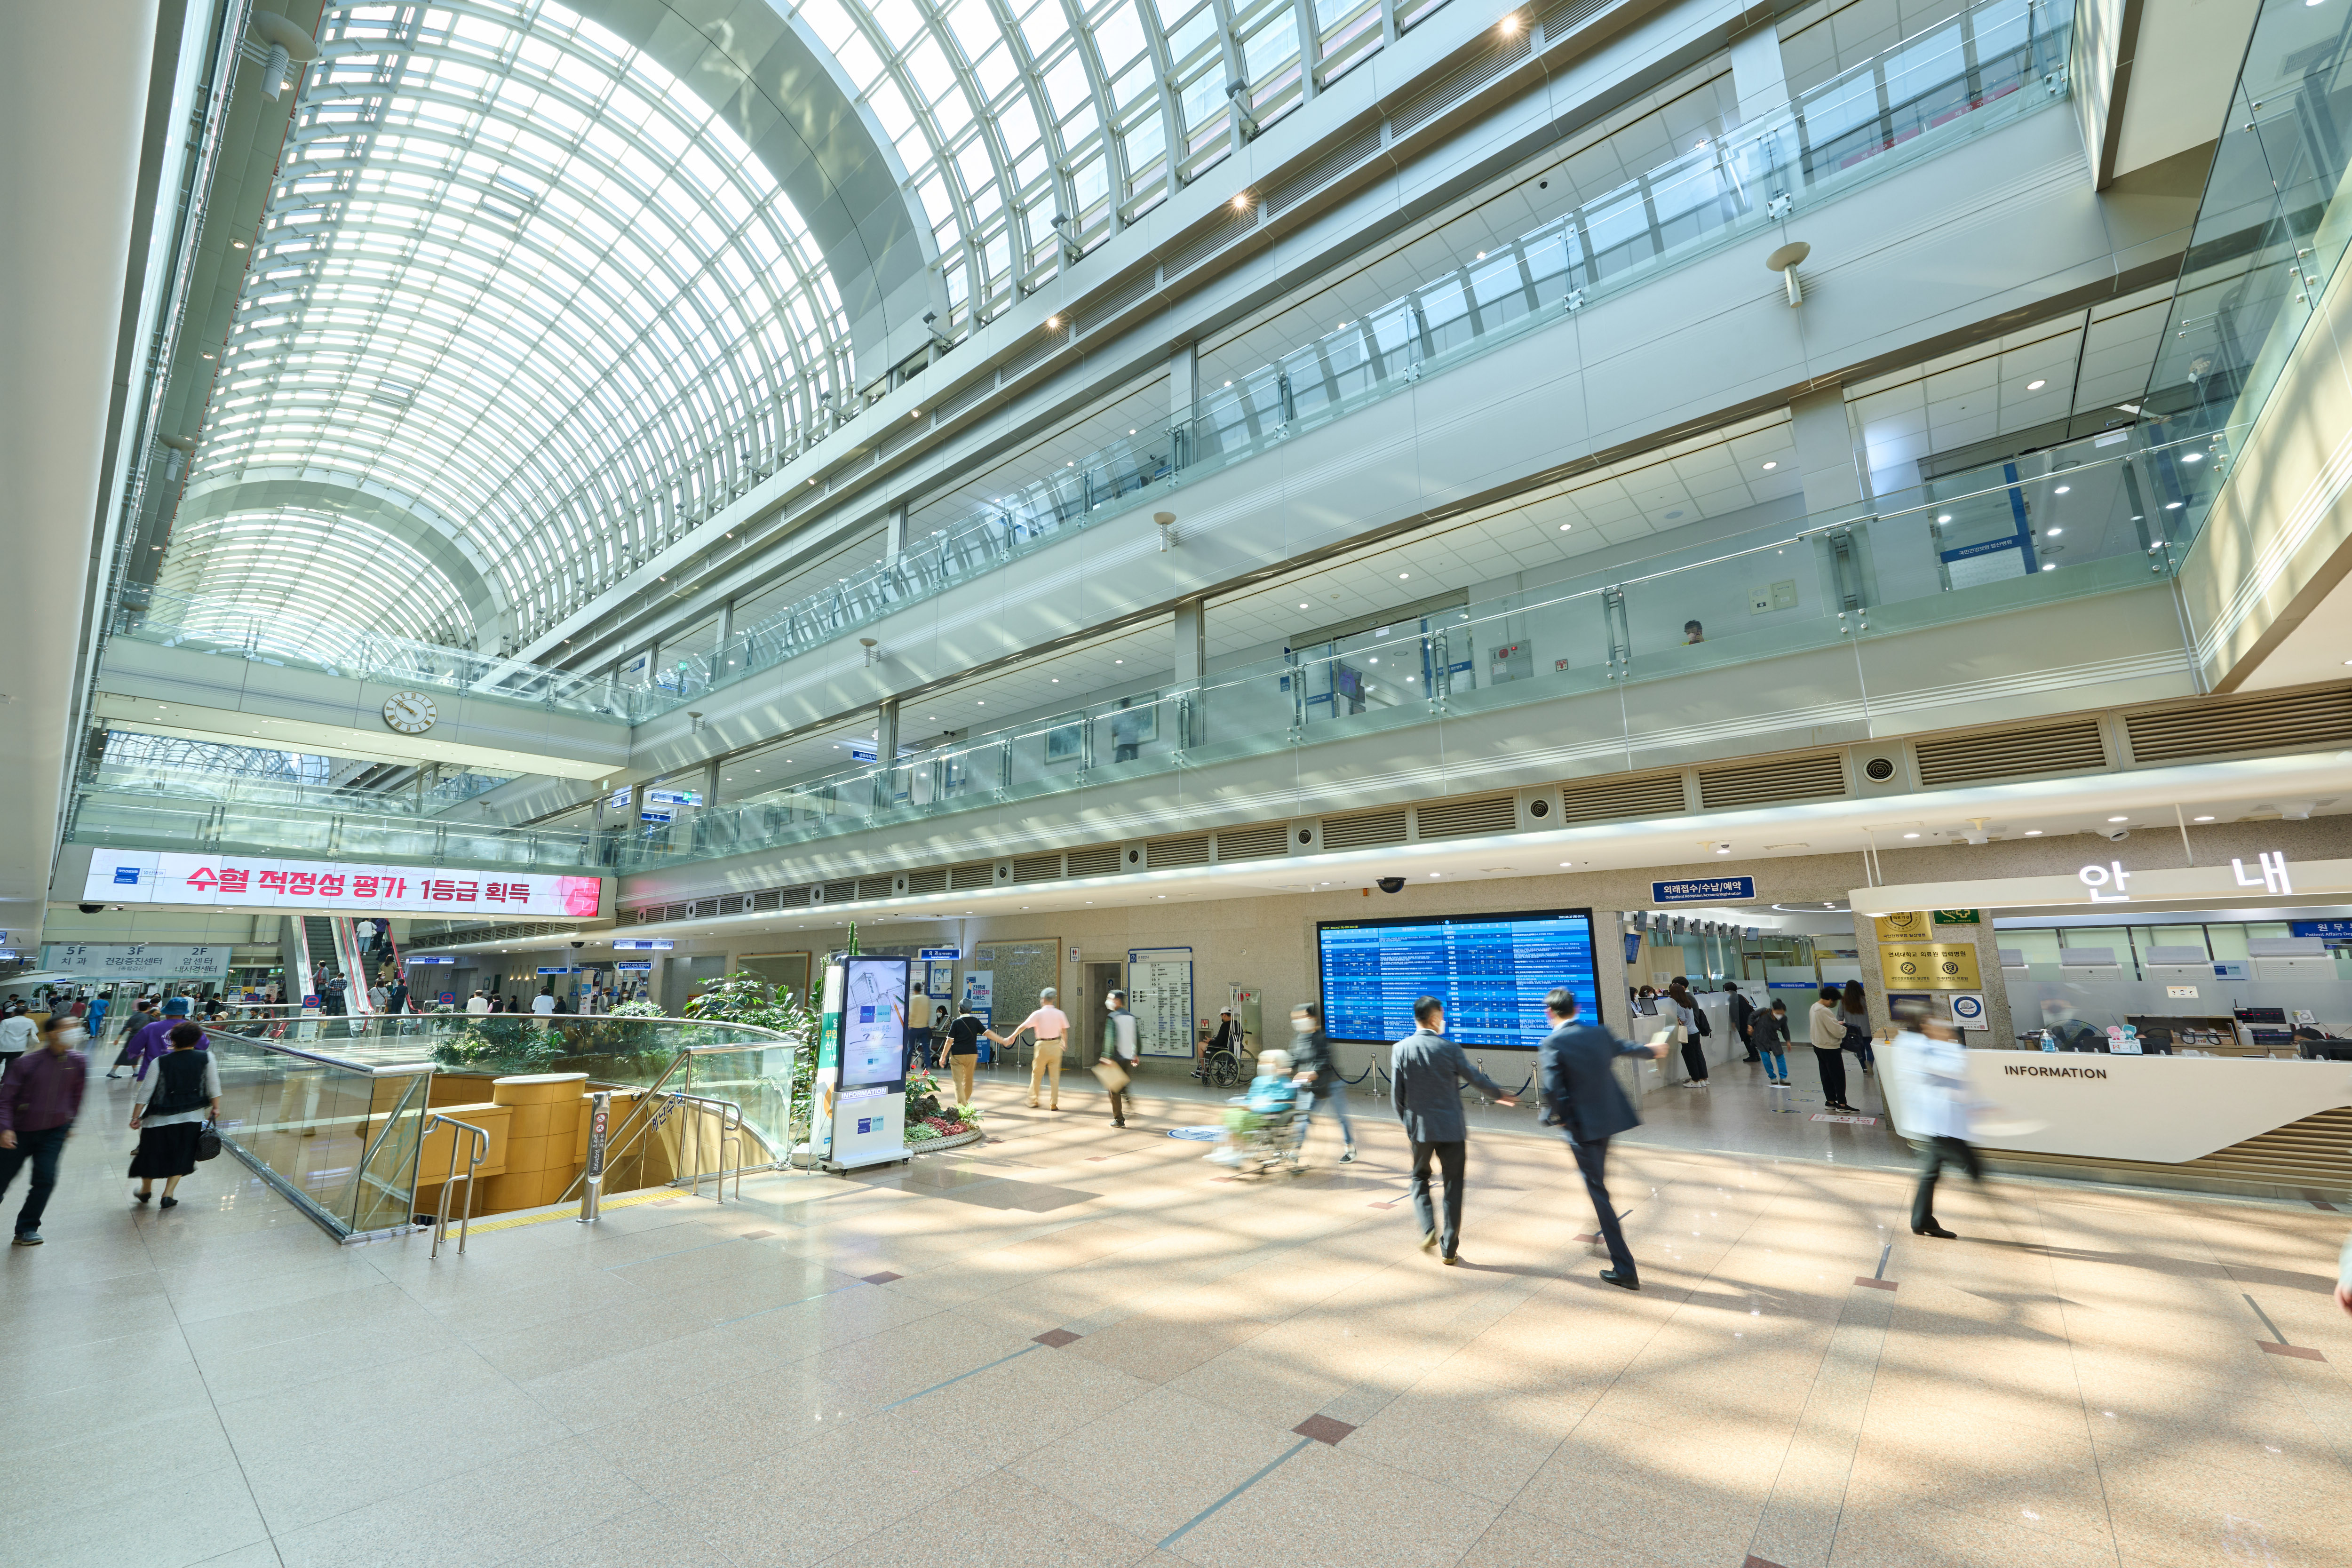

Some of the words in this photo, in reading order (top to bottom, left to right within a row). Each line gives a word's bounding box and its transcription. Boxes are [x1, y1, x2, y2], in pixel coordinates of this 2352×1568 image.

[1955, 95, 1995, 117] 제한구역
[1861, 139, 1898, 159] 제한구역
[1958, 545, 1989, 555] 국민건강보험
[1990, 539, 2012, 549] 일산병원
[186, 867, 250, 893] 수혈
[258, 870, 345, 897] 적정성
[353, 875, 407, 899] 평가
[421, 879, 479, 902] 1등급
[485, 882, 531, 904] 획득
[1663, 881, 1741, 894] 외래접수/수납/예약
[66, 947, 87, 955] 5F
[191, 947, 208, 955] 2F
[105, 957, 163, 965] 건강증진센터
[2004, 1065, 2107, 1079] INFORMATION
[841, 1088, 887, 1098] INFORMATION
